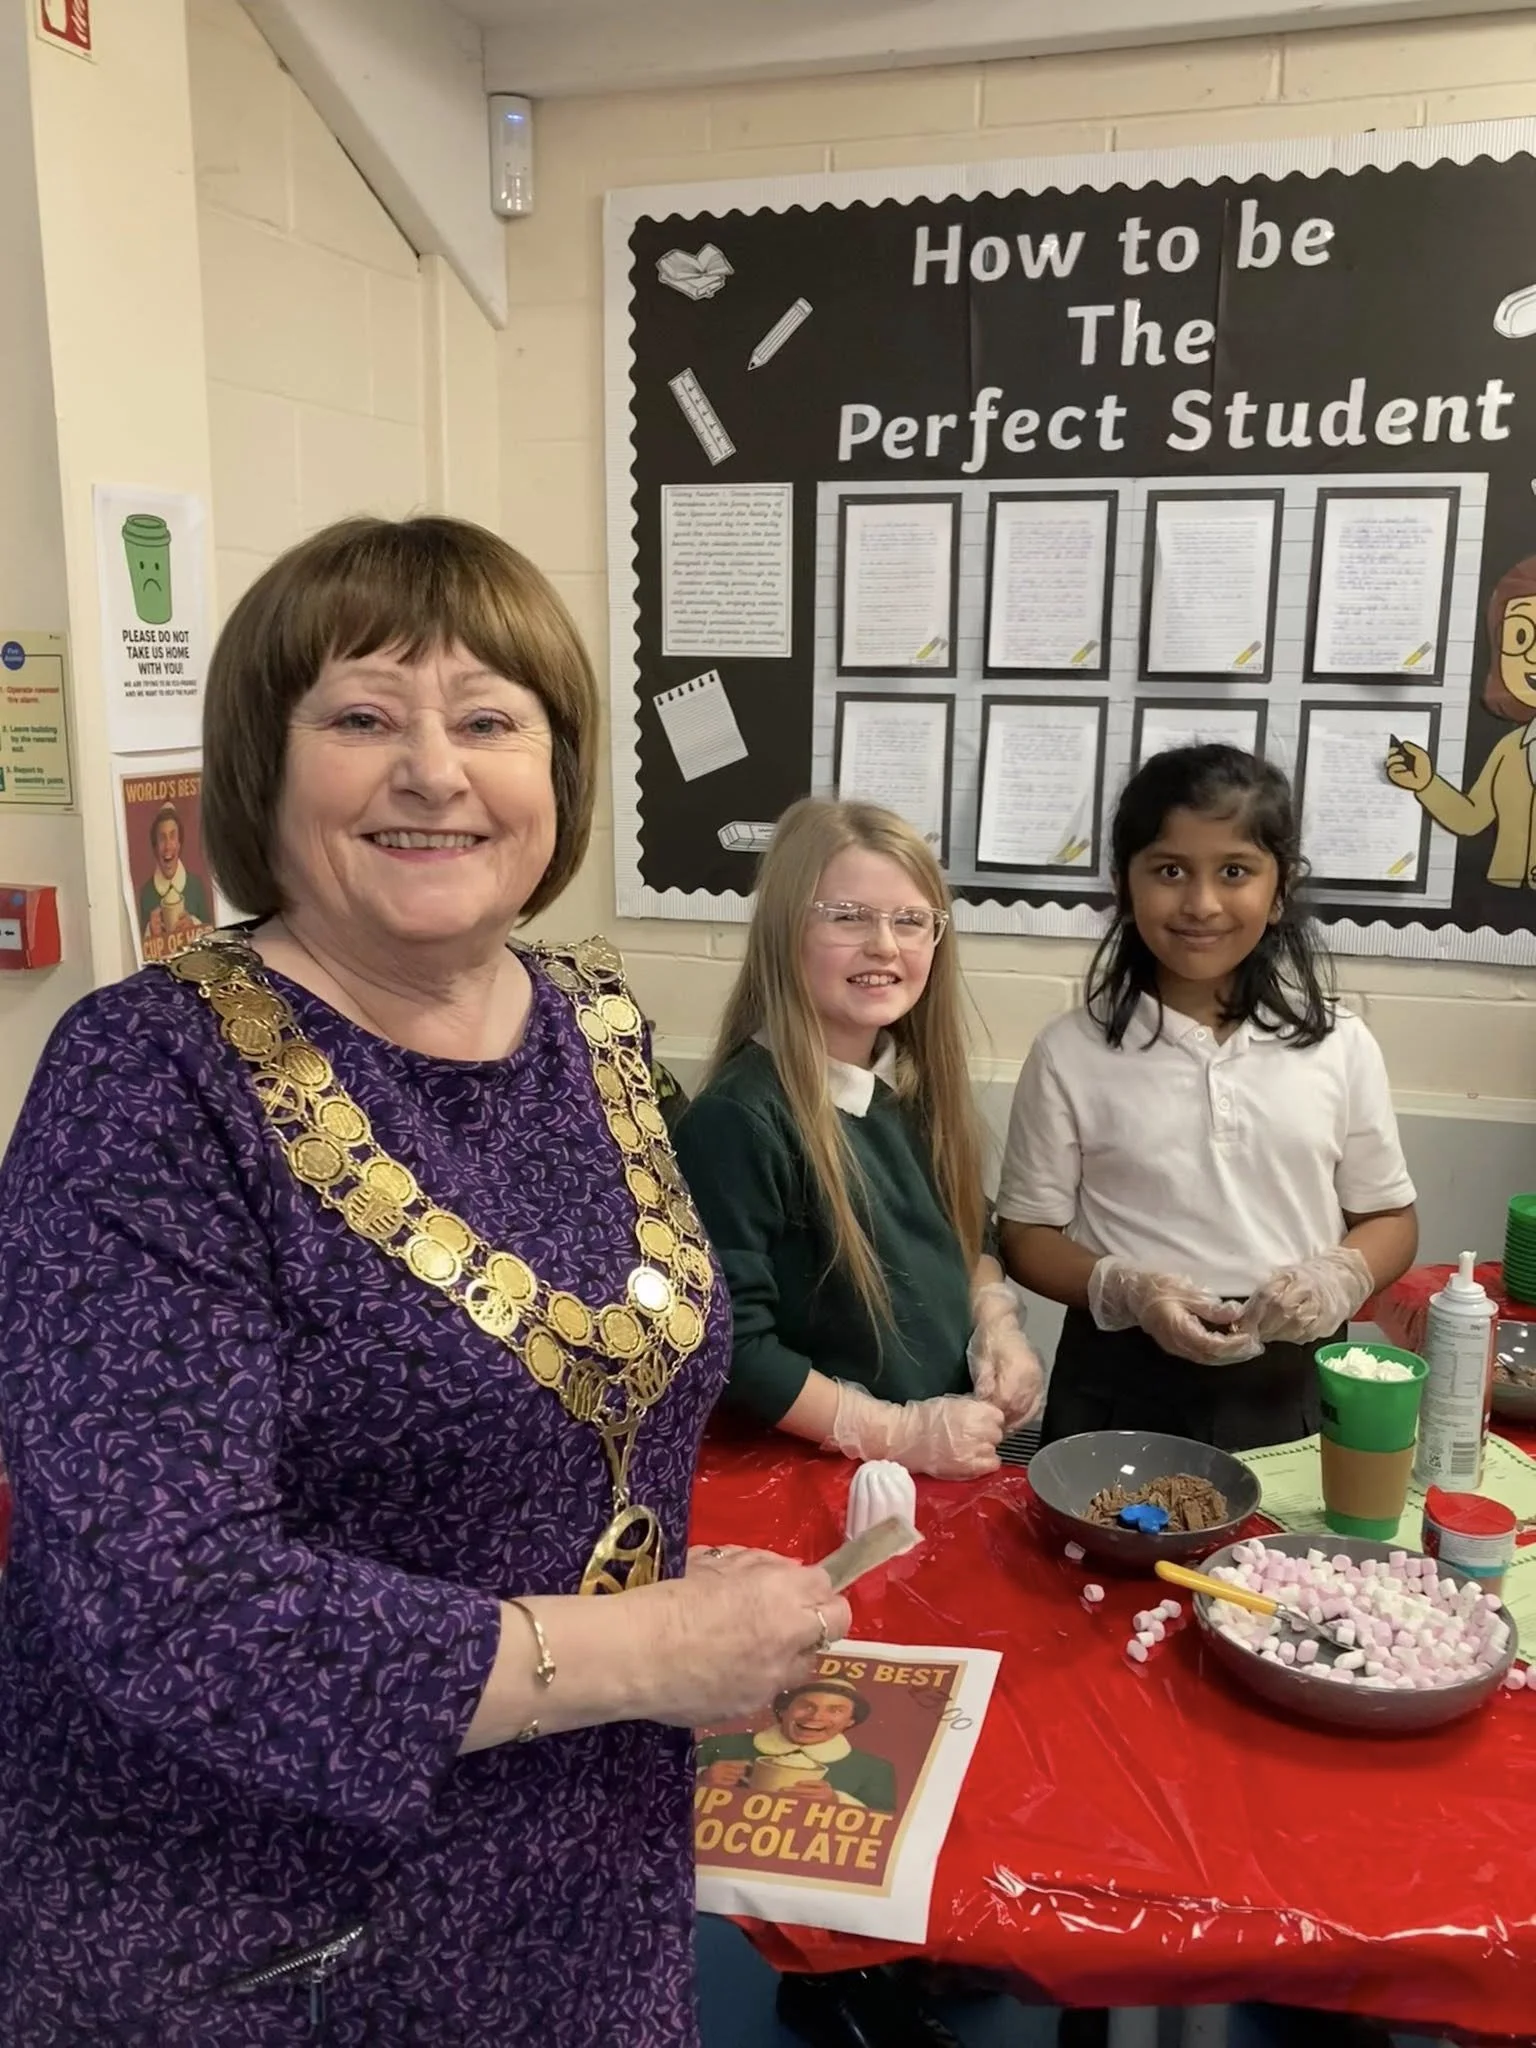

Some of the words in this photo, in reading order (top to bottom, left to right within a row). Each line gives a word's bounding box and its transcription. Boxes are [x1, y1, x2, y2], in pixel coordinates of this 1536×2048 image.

[912, 223, 1086, 287] How
[1117, 216, 1201, 277] to
[1236, 199, 1335, 270] be
[1067, 298, 1217, 367] The
[837, 386, 1127, 474] Perfect
[1165, 377, 1516, 454] Student
[122, 630, 156, 642] PLEASE
[158, 630, 171, 642] DO
[172, 631, 190, 643] NOT
[126, 646, 150, 659] TAKE
[152, 647, 164, 659] US
[165, 646, 190, 659] HOME
[138, 662, 162, 675] WITH
[163, 662, 184, 675] YOU!
[126, 780, 176, 803] WORLD'S
[872, 1663, 950, 1688] BEST
[743, 1794, 798, 1823] OF
[804, 1802, 892, 1837] HOT
